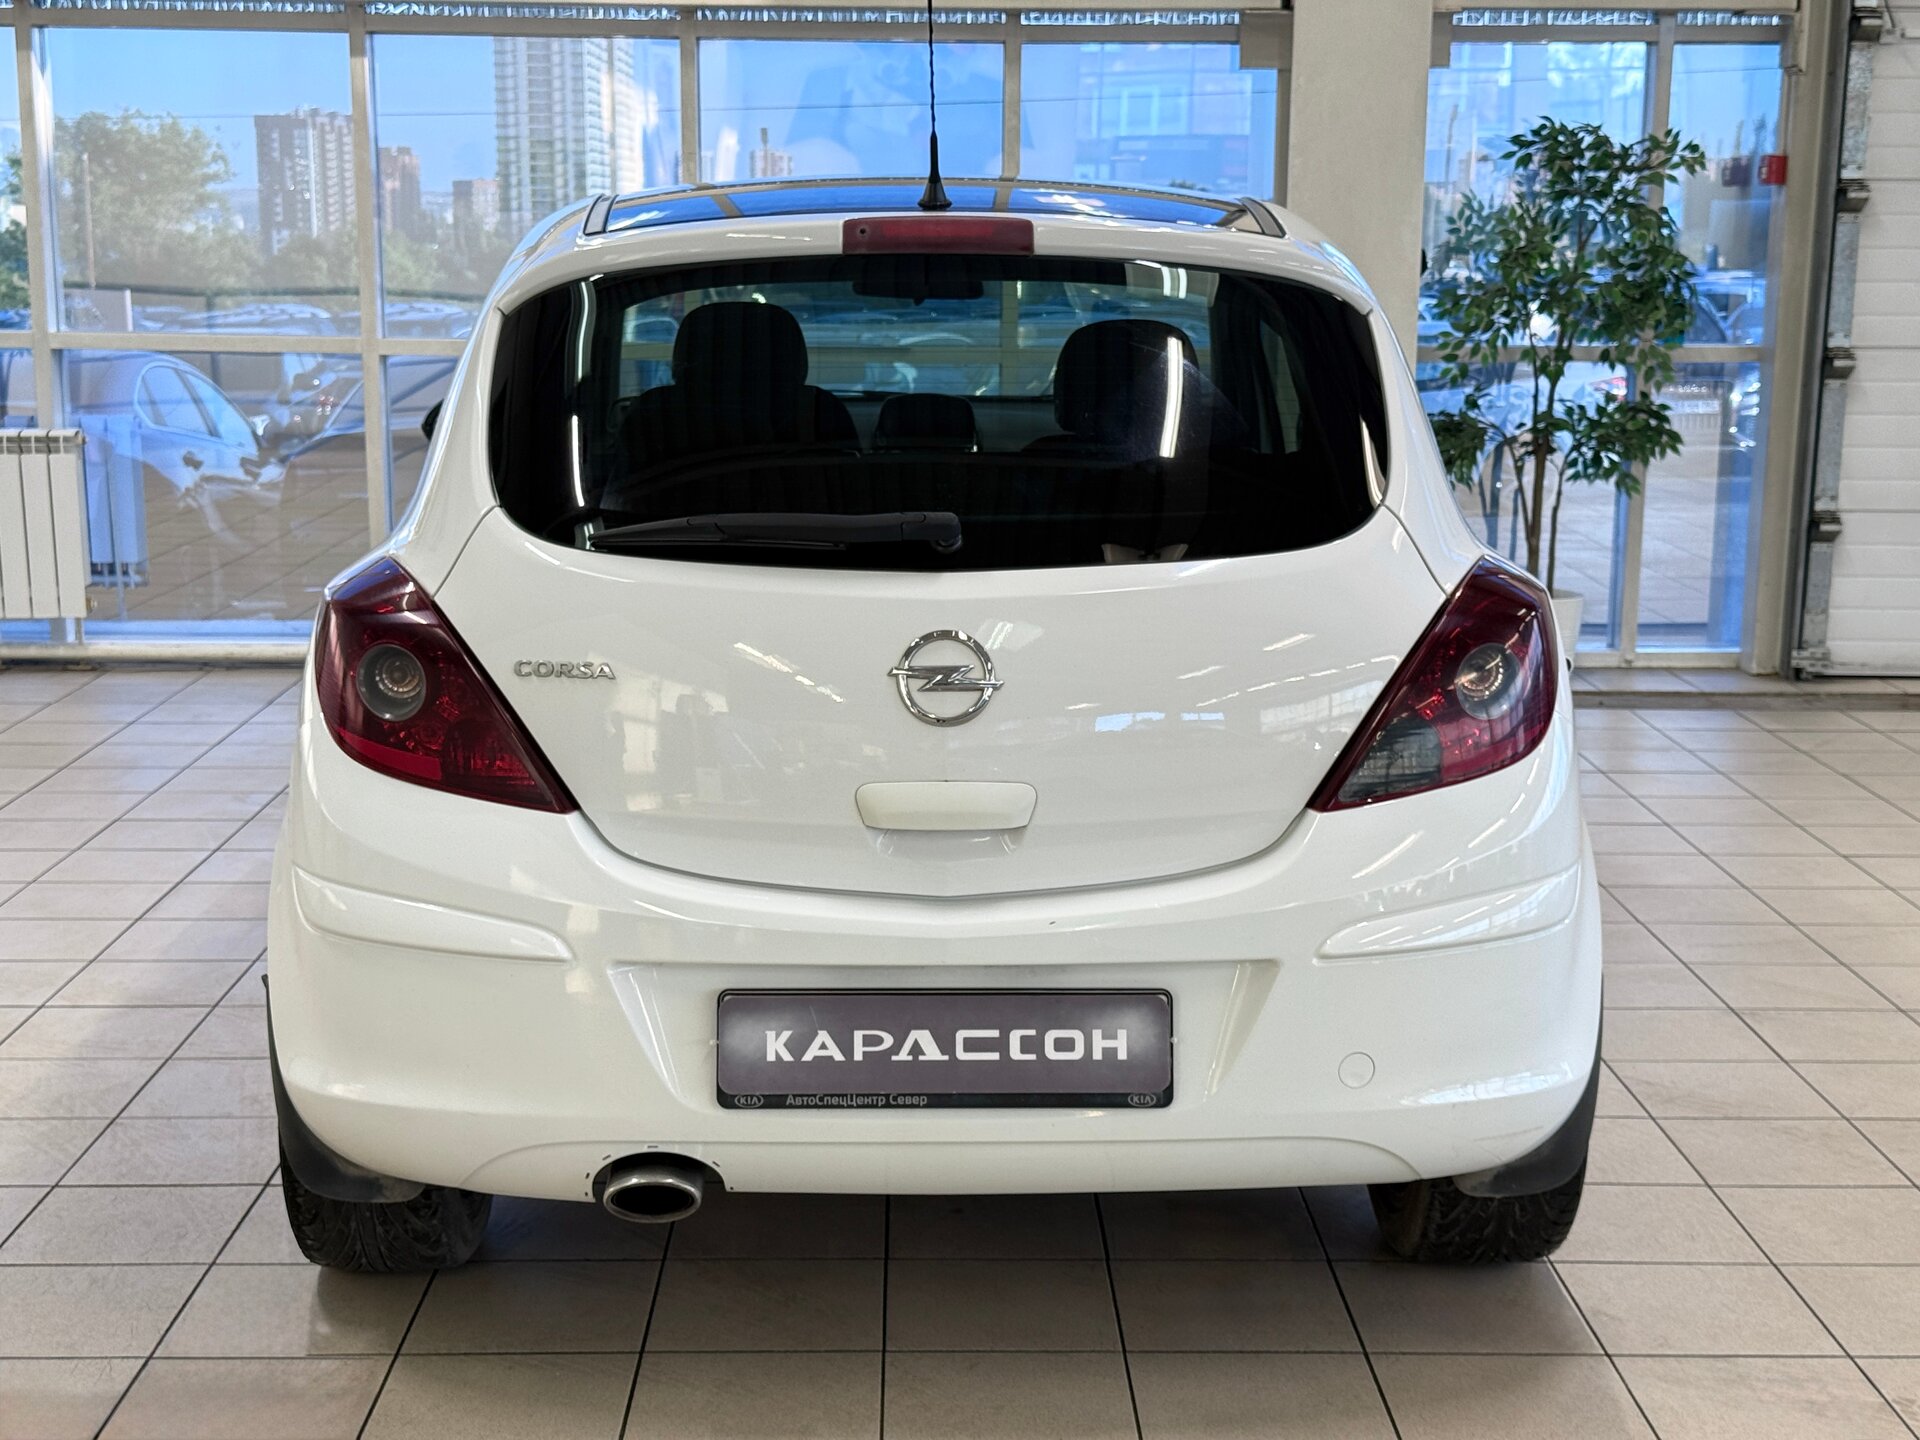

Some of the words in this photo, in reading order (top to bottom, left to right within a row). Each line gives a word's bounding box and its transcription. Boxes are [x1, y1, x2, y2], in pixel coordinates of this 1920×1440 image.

[514, 660, 616, 680] CORSA
[739, 1095, 760, 1105] KIA
[786, 1095, 886, 1107] АвтоСпецЦентр
[889, 1094, 928, 1106] Север
[1132, 1094, 1152, 1104] KIA
